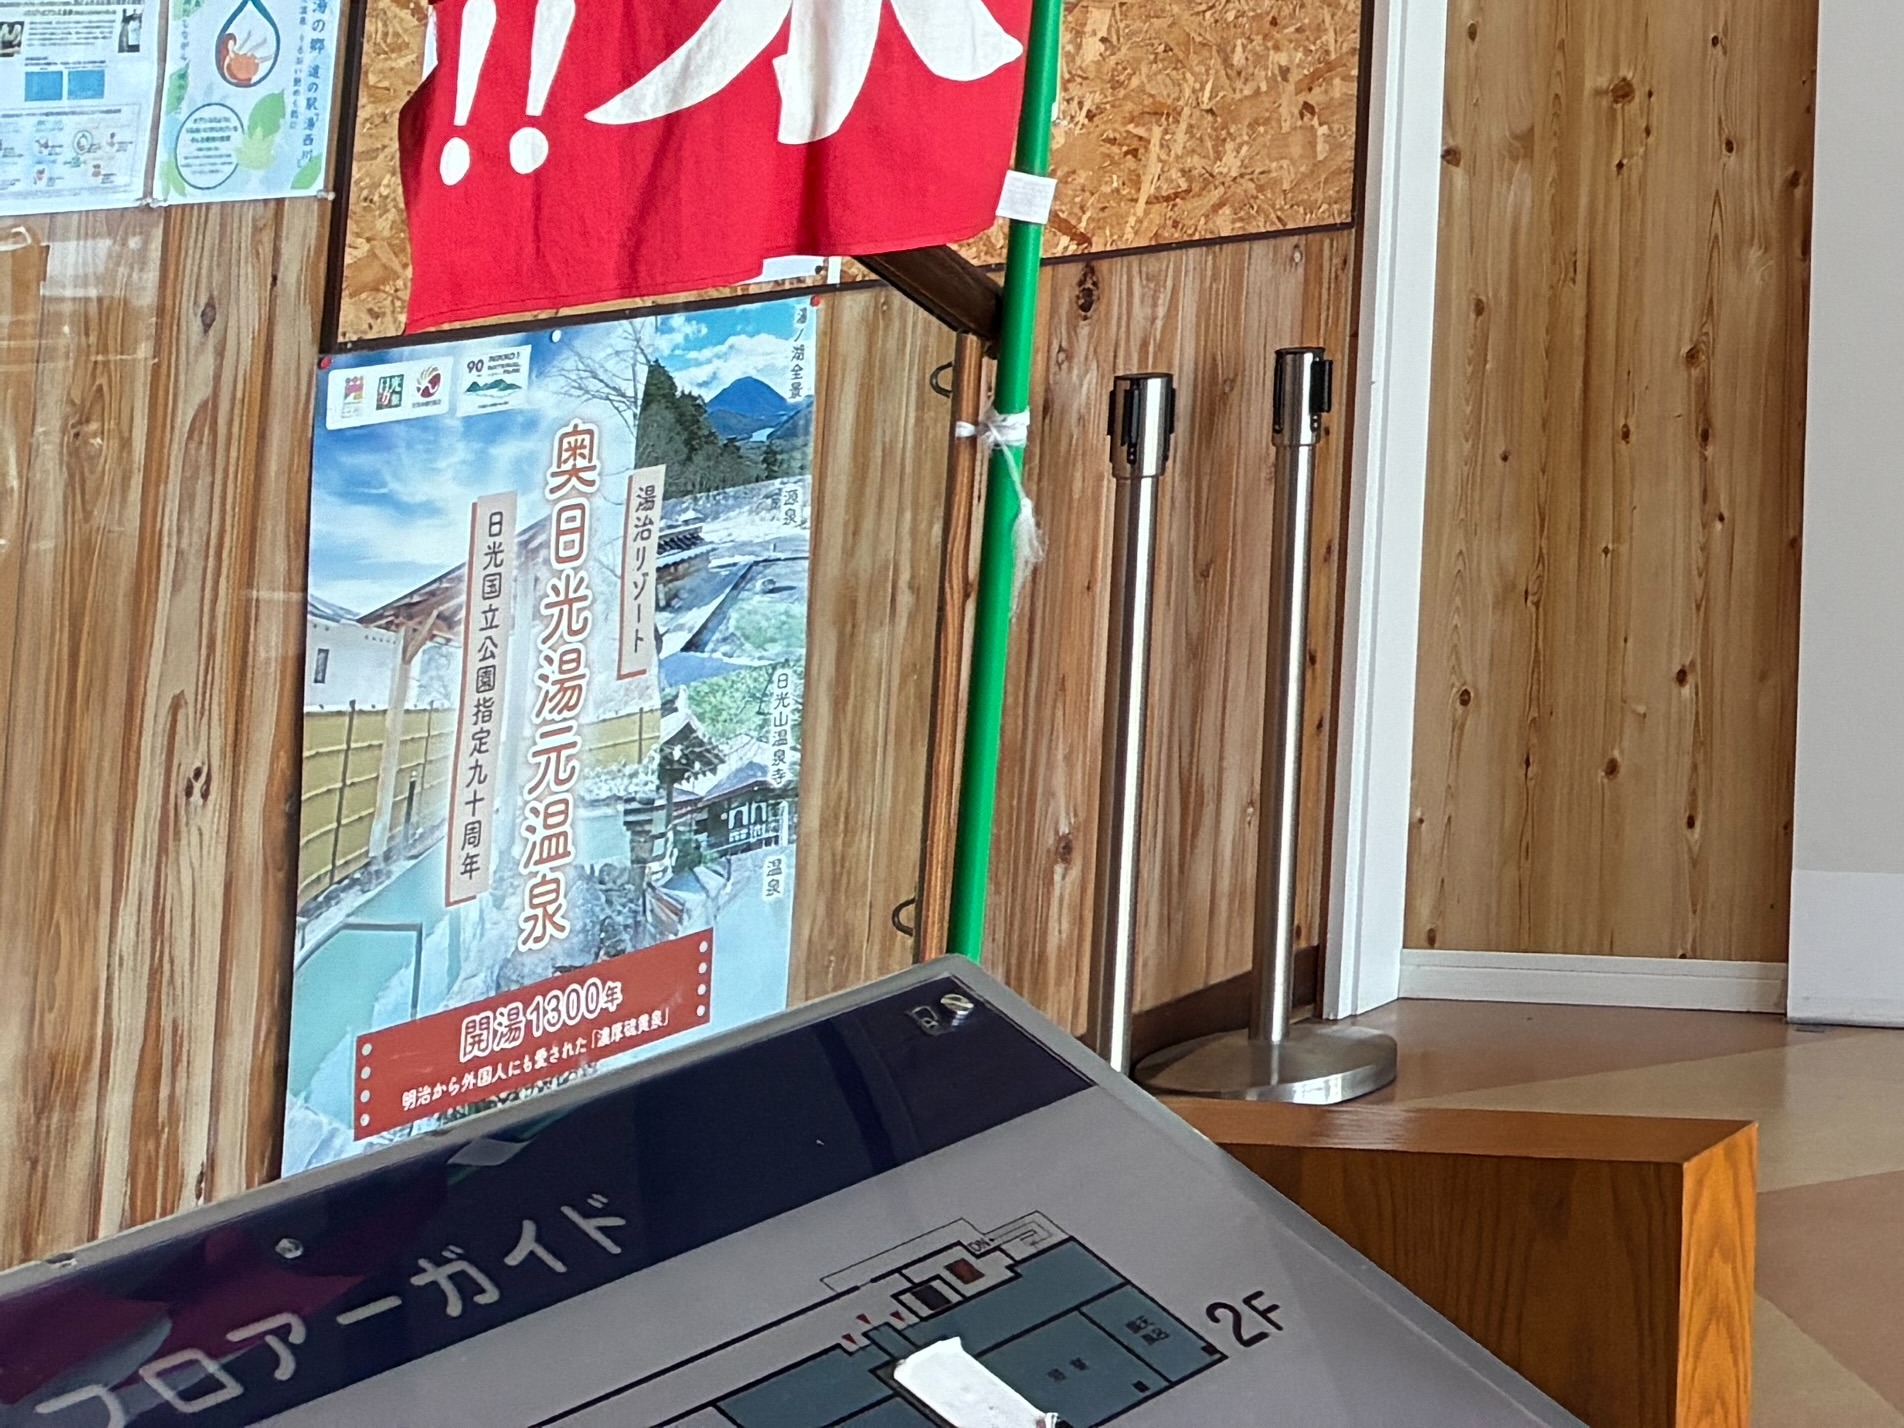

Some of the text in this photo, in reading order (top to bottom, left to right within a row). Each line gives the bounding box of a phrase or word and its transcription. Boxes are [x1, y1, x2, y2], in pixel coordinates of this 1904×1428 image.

[466, 359, 484, 375] 90
[631, 483, 658, 655] 湯治リゾート
[458, 510, 505, 882] 日光国立公園指定九十周年
[520, 421, 598, 950] 奥日光湯元温泉
[771, 671, 791, 787] 日光山温泉寺
[765, 856, 784, 897] 温泉
[460, 977, 623, 1063] 開湯1300年
[1205, 1289, 1285, 1349] 2F
